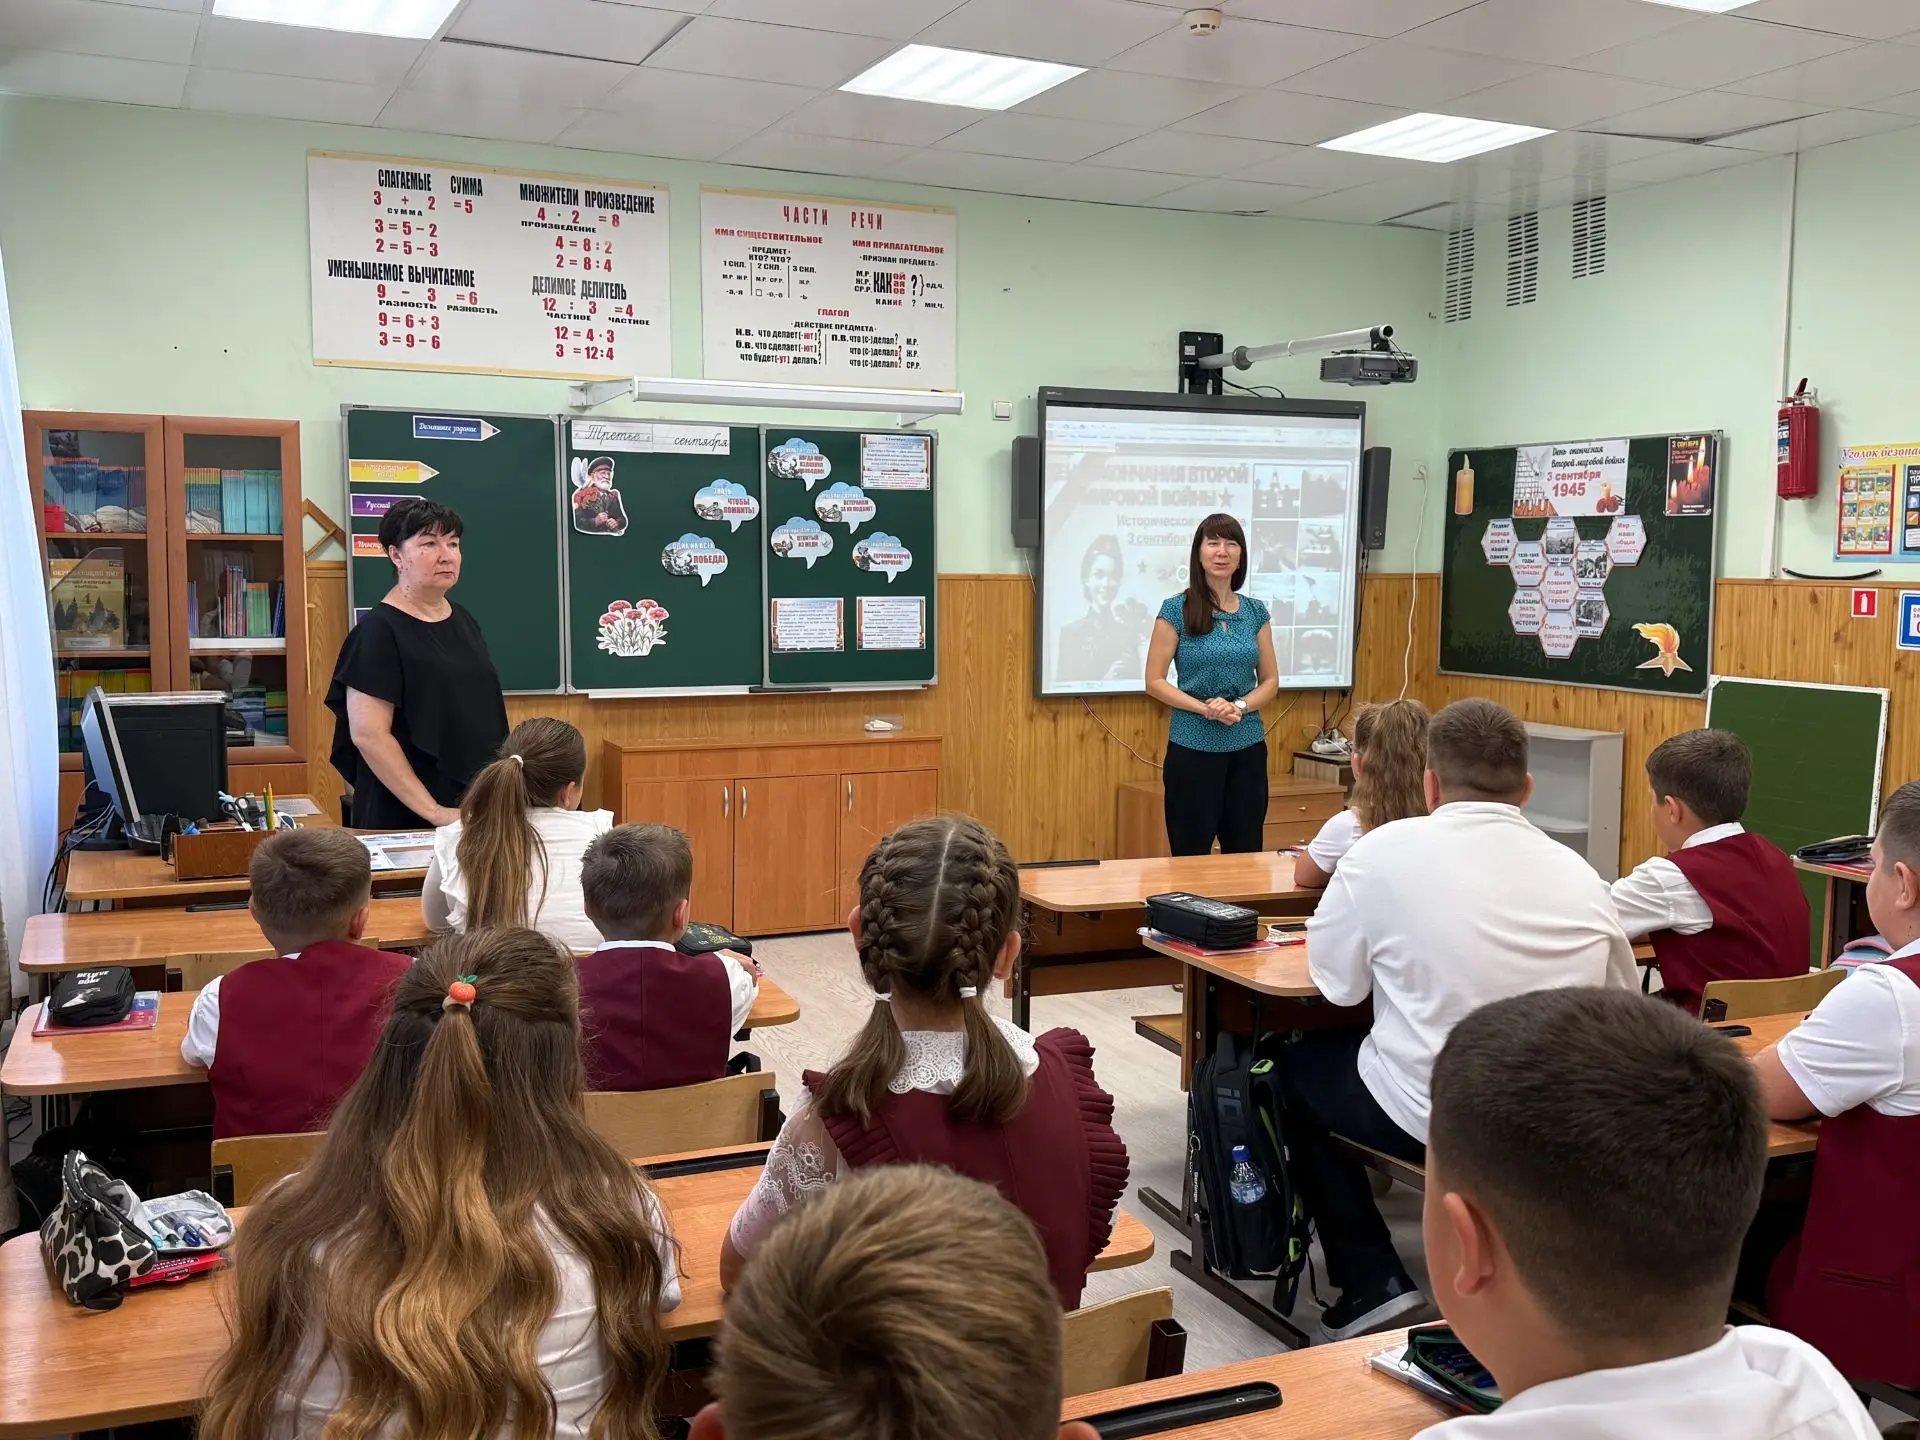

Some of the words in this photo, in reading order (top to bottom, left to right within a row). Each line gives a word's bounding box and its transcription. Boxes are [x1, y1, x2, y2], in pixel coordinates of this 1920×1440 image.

[378, 169, 432, 192] СЛАГАЕМЫЕ
[451, 176, 484, 197] СУММА
[374, 191, 382, 205] 3
[428, 196, 435, 211] 2
[464, 199, 473, 214] 5
[520, 183, 579, 207] МНОЖИТЕЛИ
[585, 190, 655, 215] ПРОИЗВЕДЕНИЕ
[387, 207, 424, 217] СУММА
[537, 207, 546, 221] 4
[571, 210, 580, 224] 2
[611, 214, 620, 228] 8
[784, 206, 828, 226] ЧАСТИ
[852, 212, 883, 231] РЕЧИ
[375, 219, 384, 233] 3
[402, 221, 412, 235] 5
[429, 223, 438, 238] 2
[521, 221, 597, 234] ПРОИЗВЕДЕНИЕ
[715, 228, 735, 237] ИМЯ
[737, 230, 823, 245] СУЩЕСТВИТЕЛЬНОЕ
[375, 238, 385, 253] 2
[403, 241, 412, 256] 5
[429, 243, 438, 257] 3
[556, 236, 564, 250] 4
[583, 238, 592, 252] 8
[604, 241, 613, 255] 2
[853, 240, 871, 248] ИМЯ
[872, 241, 945, 254] ПРИЛАГАТЕЛЬНОЕ
[556, 254, 565, 268] 2
[583, 257, 592, 271] 8
[604, 259, 613, 272] 4
[328, 259, 404, 283] УМЕНЬШАЕМОЕ
[408, 266, 475, 288] ВЫЧИТАЕМОЕ
[532, 276, 577, 297] ДЕЛИМОЕ
[580, 280, 627, 301] ДЕЛИТЕЛЬ
[873, 271, 893, 295] КАК
[377, 284, 386, 298] 9
[427, 288, 437, 302] 3
[469, 291, 478, 306] 6
[379, 300, 437, 310] РАЗНОСТЬ
[446, 304, 499, 315] РАЗНОСТЬ
[542, 297, 557, 311] 12
[588, 301, 597, 315] 3
[625, 304, 634, 318] 4
[817, 308, 850, 318] ГЛАГОЛ
[378, 312, 388, 326] 9
[405, 314, 414, 329] 6
[431, 316, 440, 330] 3
[546, 312, 592, 322] ЧАСТНОЕ
[608, 317, 651, 326] ЧАСТНОЕ
[379, 332, 388, 347] 3
[405, 334, 415, 348] 9
[432, 335, 441, 349] 6
[554, 326, 569, 340] 12
[586, 328, 595, 342] 4
[606, 329, 615, 343] 3
[556, 344, 564, 358] 3
[586, 425, 640, 446] Третье
[674, 433, 729, 452] сентября
[1842, 448, 1884, 460] Уголок
[1188, 463, 1248, 483] ВТОРОЙ
[1547, 472, 1553, 482] 3
[1555, 469, 1602, 482] сентября
[1552, 482, 1586, 498] 1945
[727, 498, 750, 506] ЧТОБЫ
[693, 555, 726, 565] ПОБЕДА!
